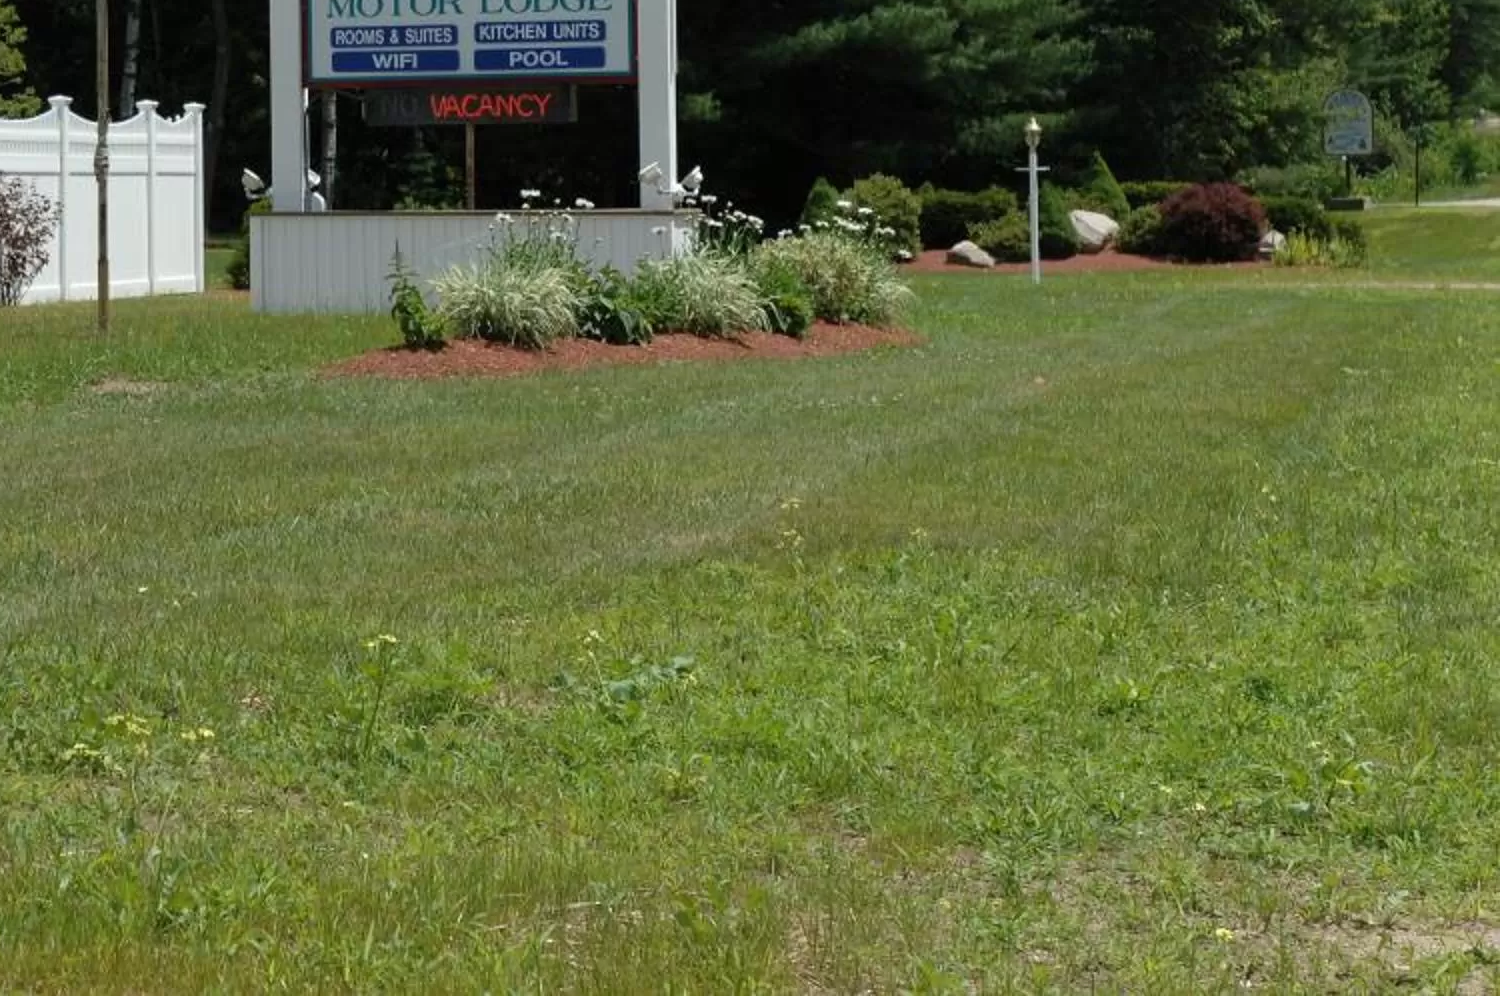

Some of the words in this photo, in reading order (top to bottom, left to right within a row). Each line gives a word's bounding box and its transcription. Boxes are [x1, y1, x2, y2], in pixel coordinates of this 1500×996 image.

[335, 29, 386, 46] ROOMS
[390, 29, 399, 44] &
[405, 26, 453, 44] SUITES
[479, 24, 547, 40] KITCHEN
[553, 23, 600, 39] UNITS
[371, 52, 419, 69] WIFI
[509, 50, 568, 67] POOL
[429, 93, 552, 119] VACANCY
